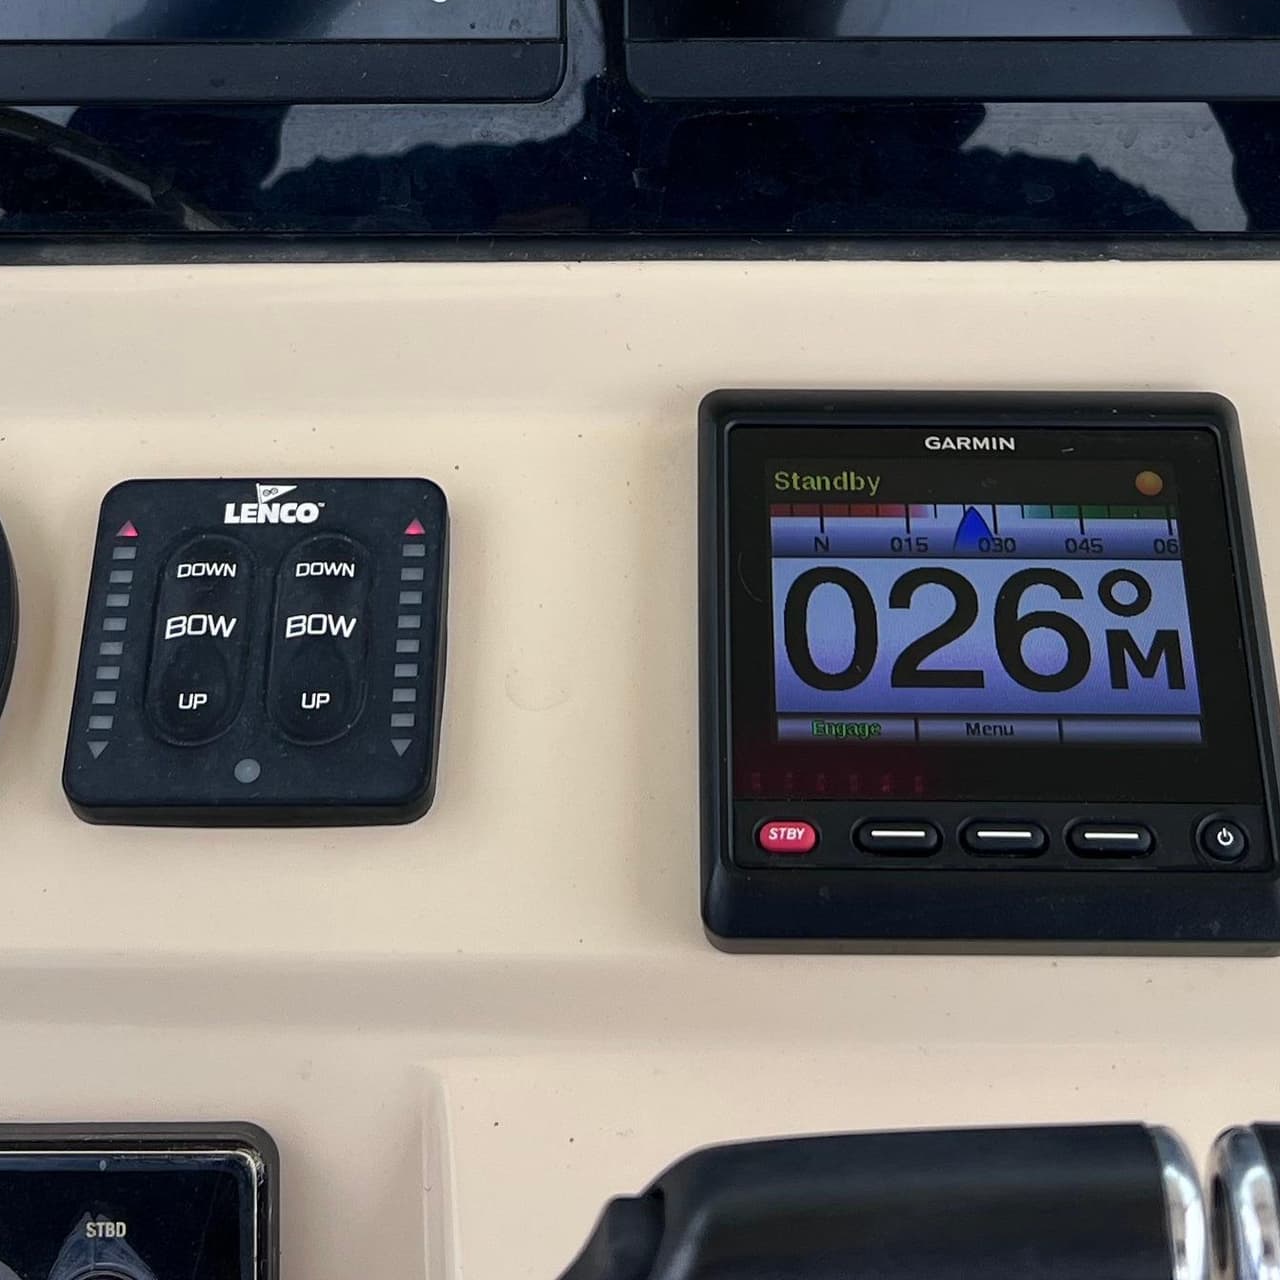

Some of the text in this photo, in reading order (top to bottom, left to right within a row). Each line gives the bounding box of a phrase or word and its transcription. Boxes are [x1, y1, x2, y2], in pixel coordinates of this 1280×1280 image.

[924, 435, 1015, 451] GARMIN
[774, 470, 881, 496] Standby
[224, 501, 320, 524] LENCO
[815, 537, 830, 552] N
[890, 537, 929, 553] 015
[978, 537, 1016, 553] 030
[1065, 537, 1103, 553] 045
[177, 563, 236, 578] DOWN
[295, 563, 355, 578] DOWN
[165, 614, 237, 639] BOW
[285, 614, 357, 639] BOW
[177, 692, 207, 709] UP
[301, 692, 330, 709] UP
[812, 720, 881, 739] Engage
[965, 721, 1014, 736] Menu
[768, 828, 805, 840] STBY
[86, 1222, 126, 1238] STBD
